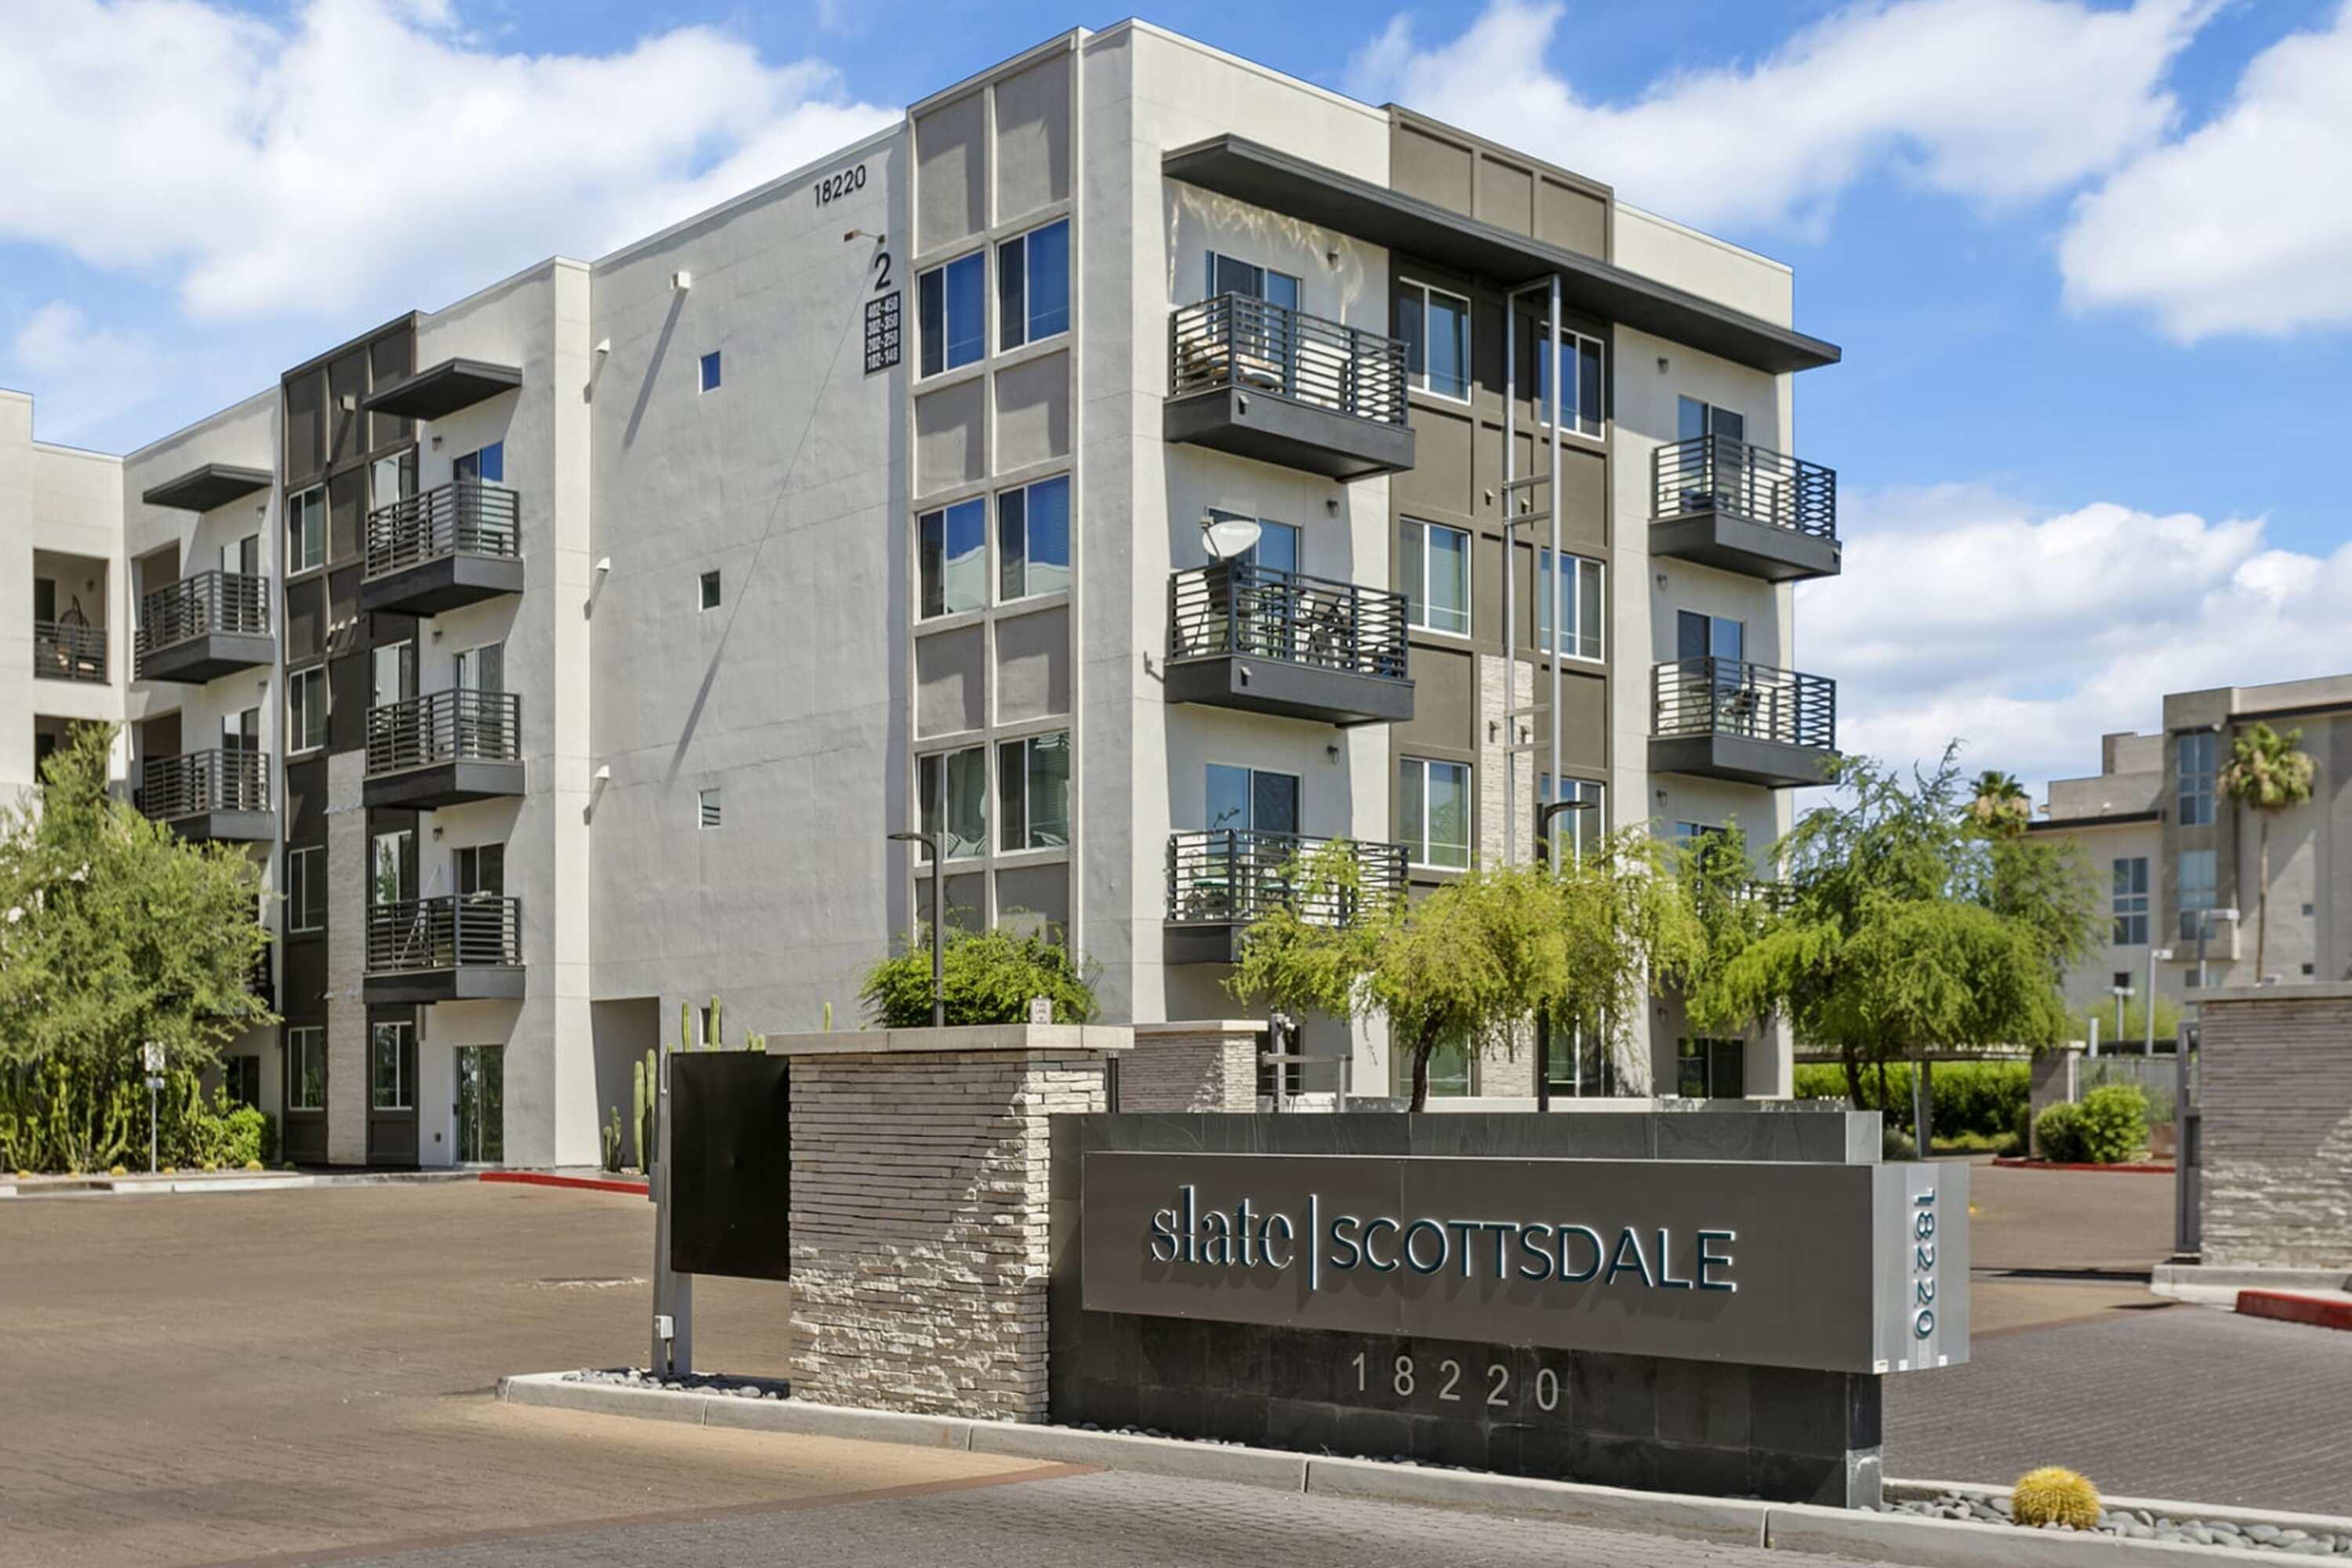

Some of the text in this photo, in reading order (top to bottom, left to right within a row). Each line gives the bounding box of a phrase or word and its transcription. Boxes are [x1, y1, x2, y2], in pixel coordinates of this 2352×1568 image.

[815, 165, 866, 207] 18220
[875, 252, 891, 291] 2
[867, 329, 898, 353] 202-250
[1151, 1185, 1737, 1292] slate SCOTTSDALE
[1913, 1187, 1935, 1339] 18220
[1352, 1352, 1559, 1410] 18220
